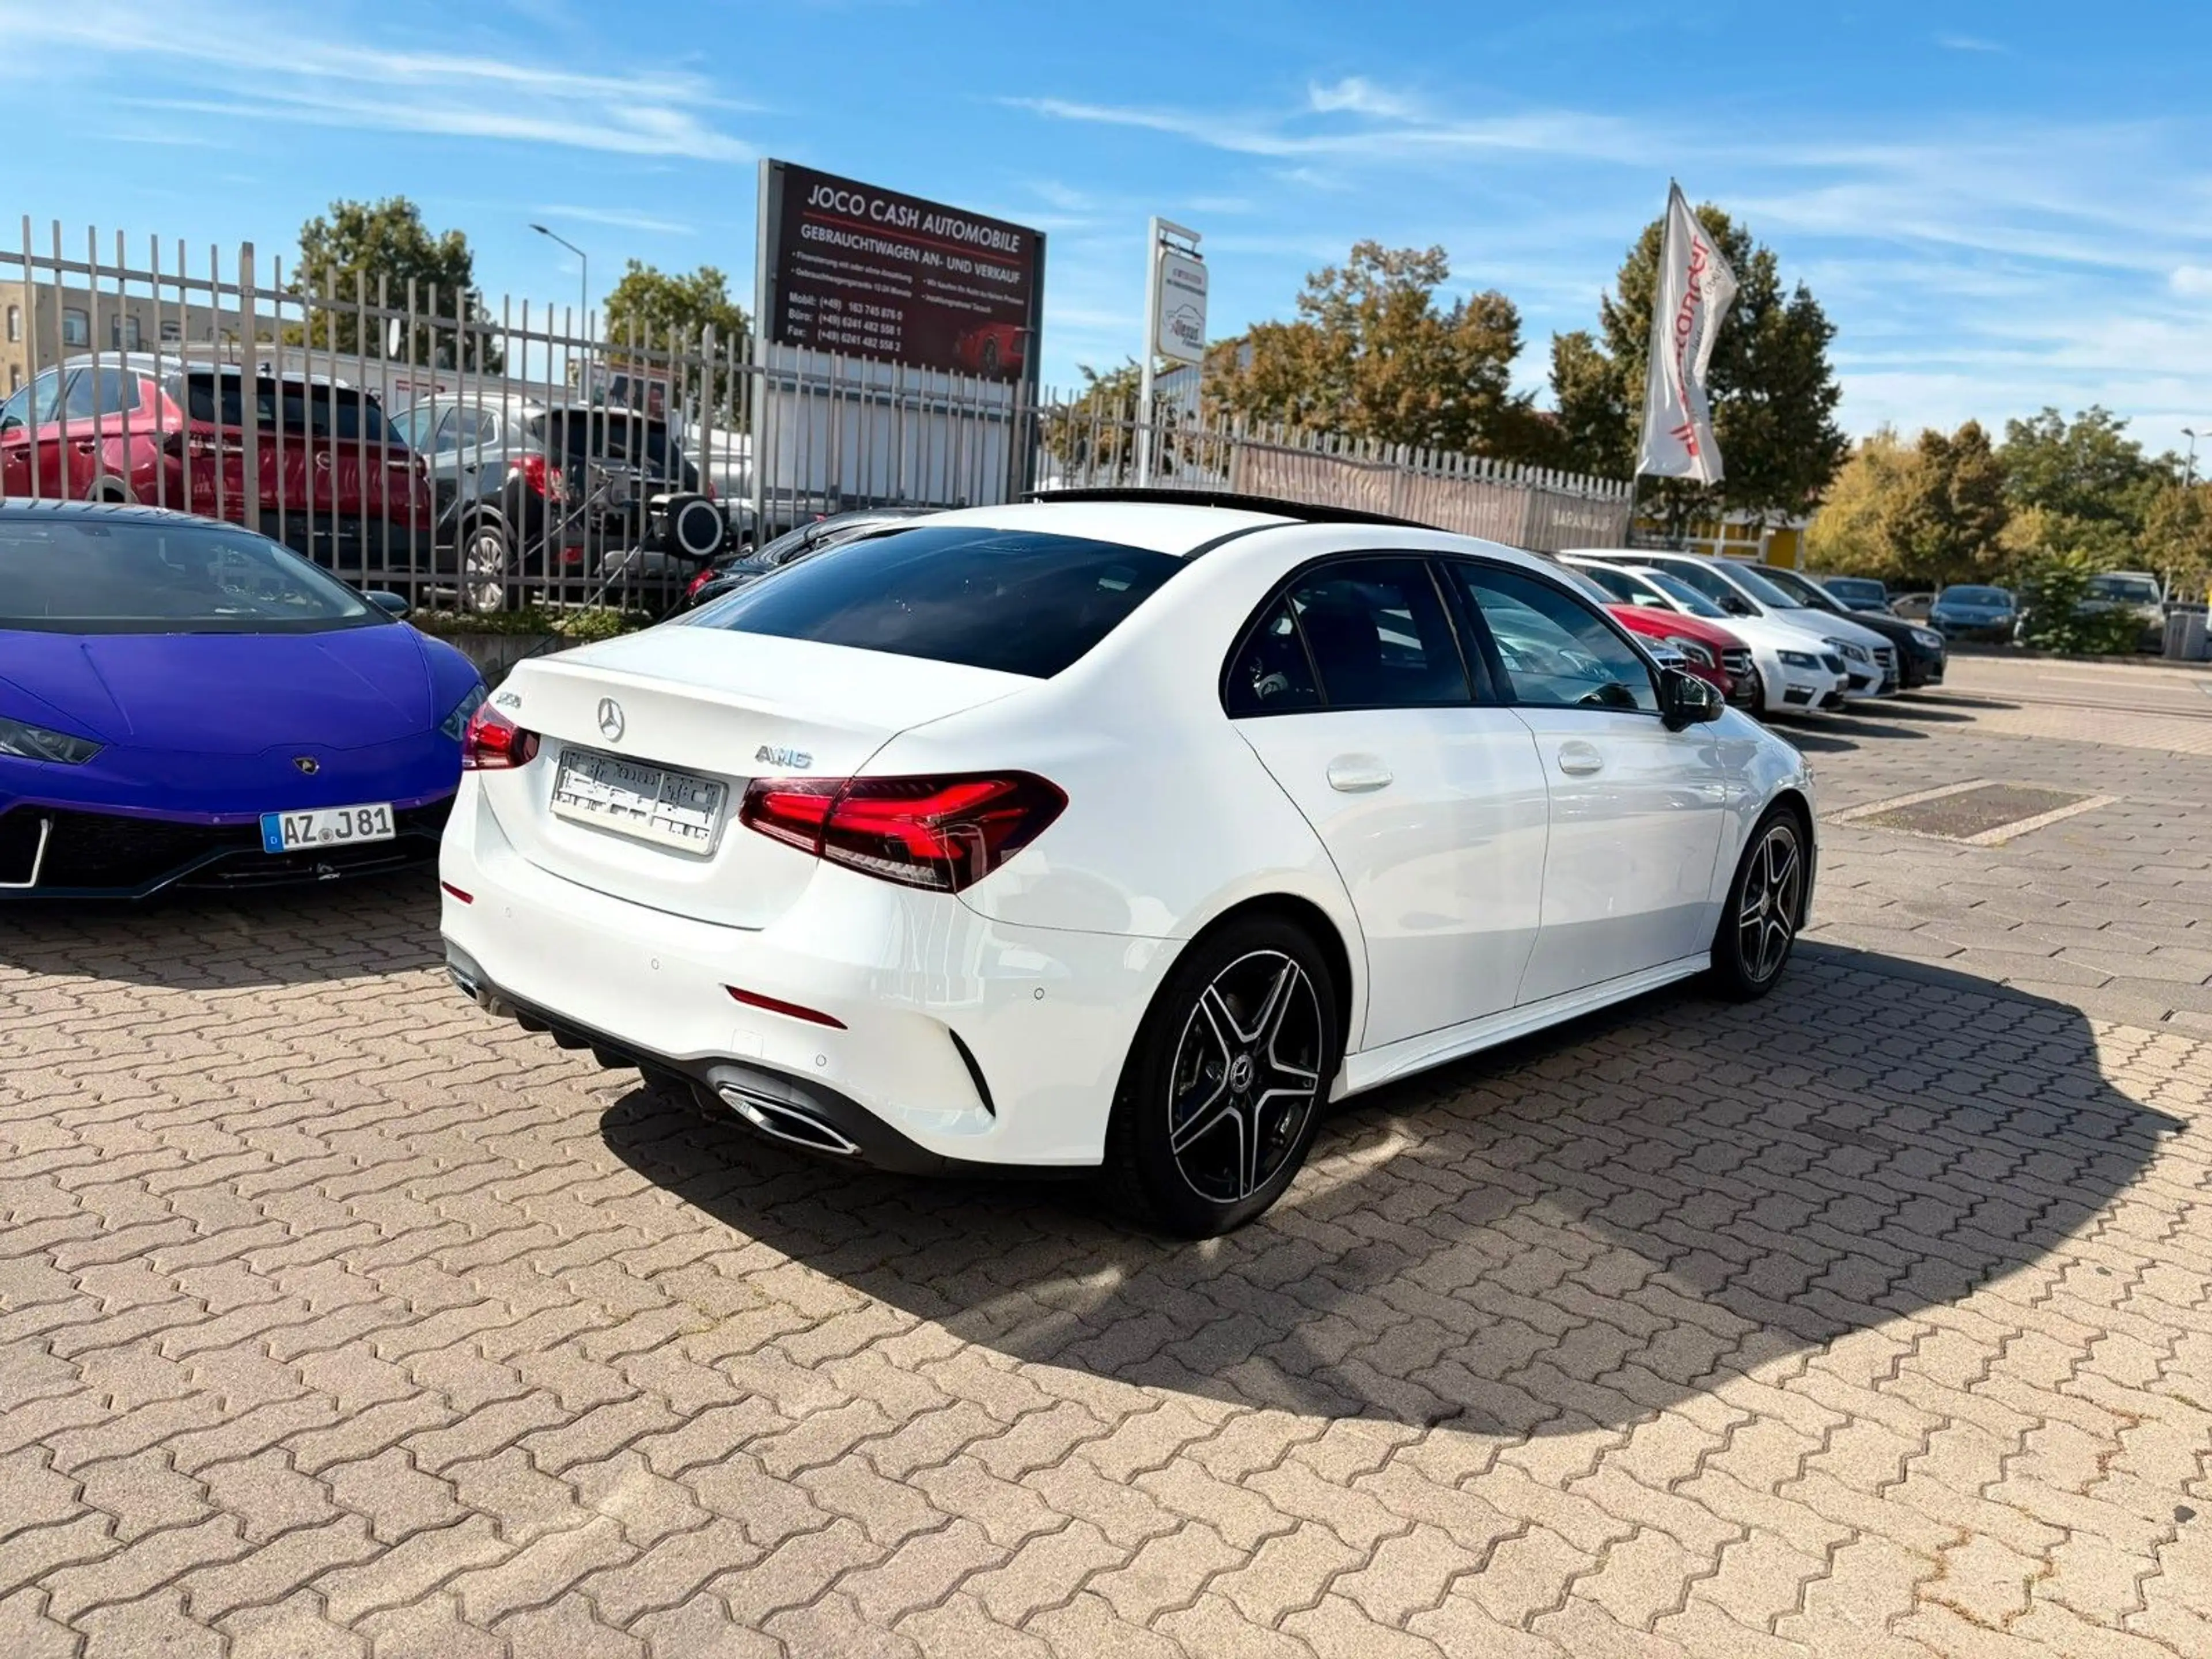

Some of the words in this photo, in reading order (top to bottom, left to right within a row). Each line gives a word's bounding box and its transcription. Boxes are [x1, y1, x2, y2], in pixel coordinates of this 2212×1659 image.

[808, 184, 866, 216] JOCO
[870, 199, 920, 229] CASH
[922, 213, 1021, 253] AUTOMOBILE
[801, 224, 920, 262] GEBRAUCHTWAGEN
[922, 251, 944, 267] AN-
[946, 256, 972, 273] UND
[974, 262, 1021, 285] VERKAUF
[789, 291, 816, 306] Mobil:
[788, 308, 813, 322] Büro:
[787, 324, 807, 338] Fax:
[755, 745, 814, 769] AMG
[284, 815, 317, 844] AZ
